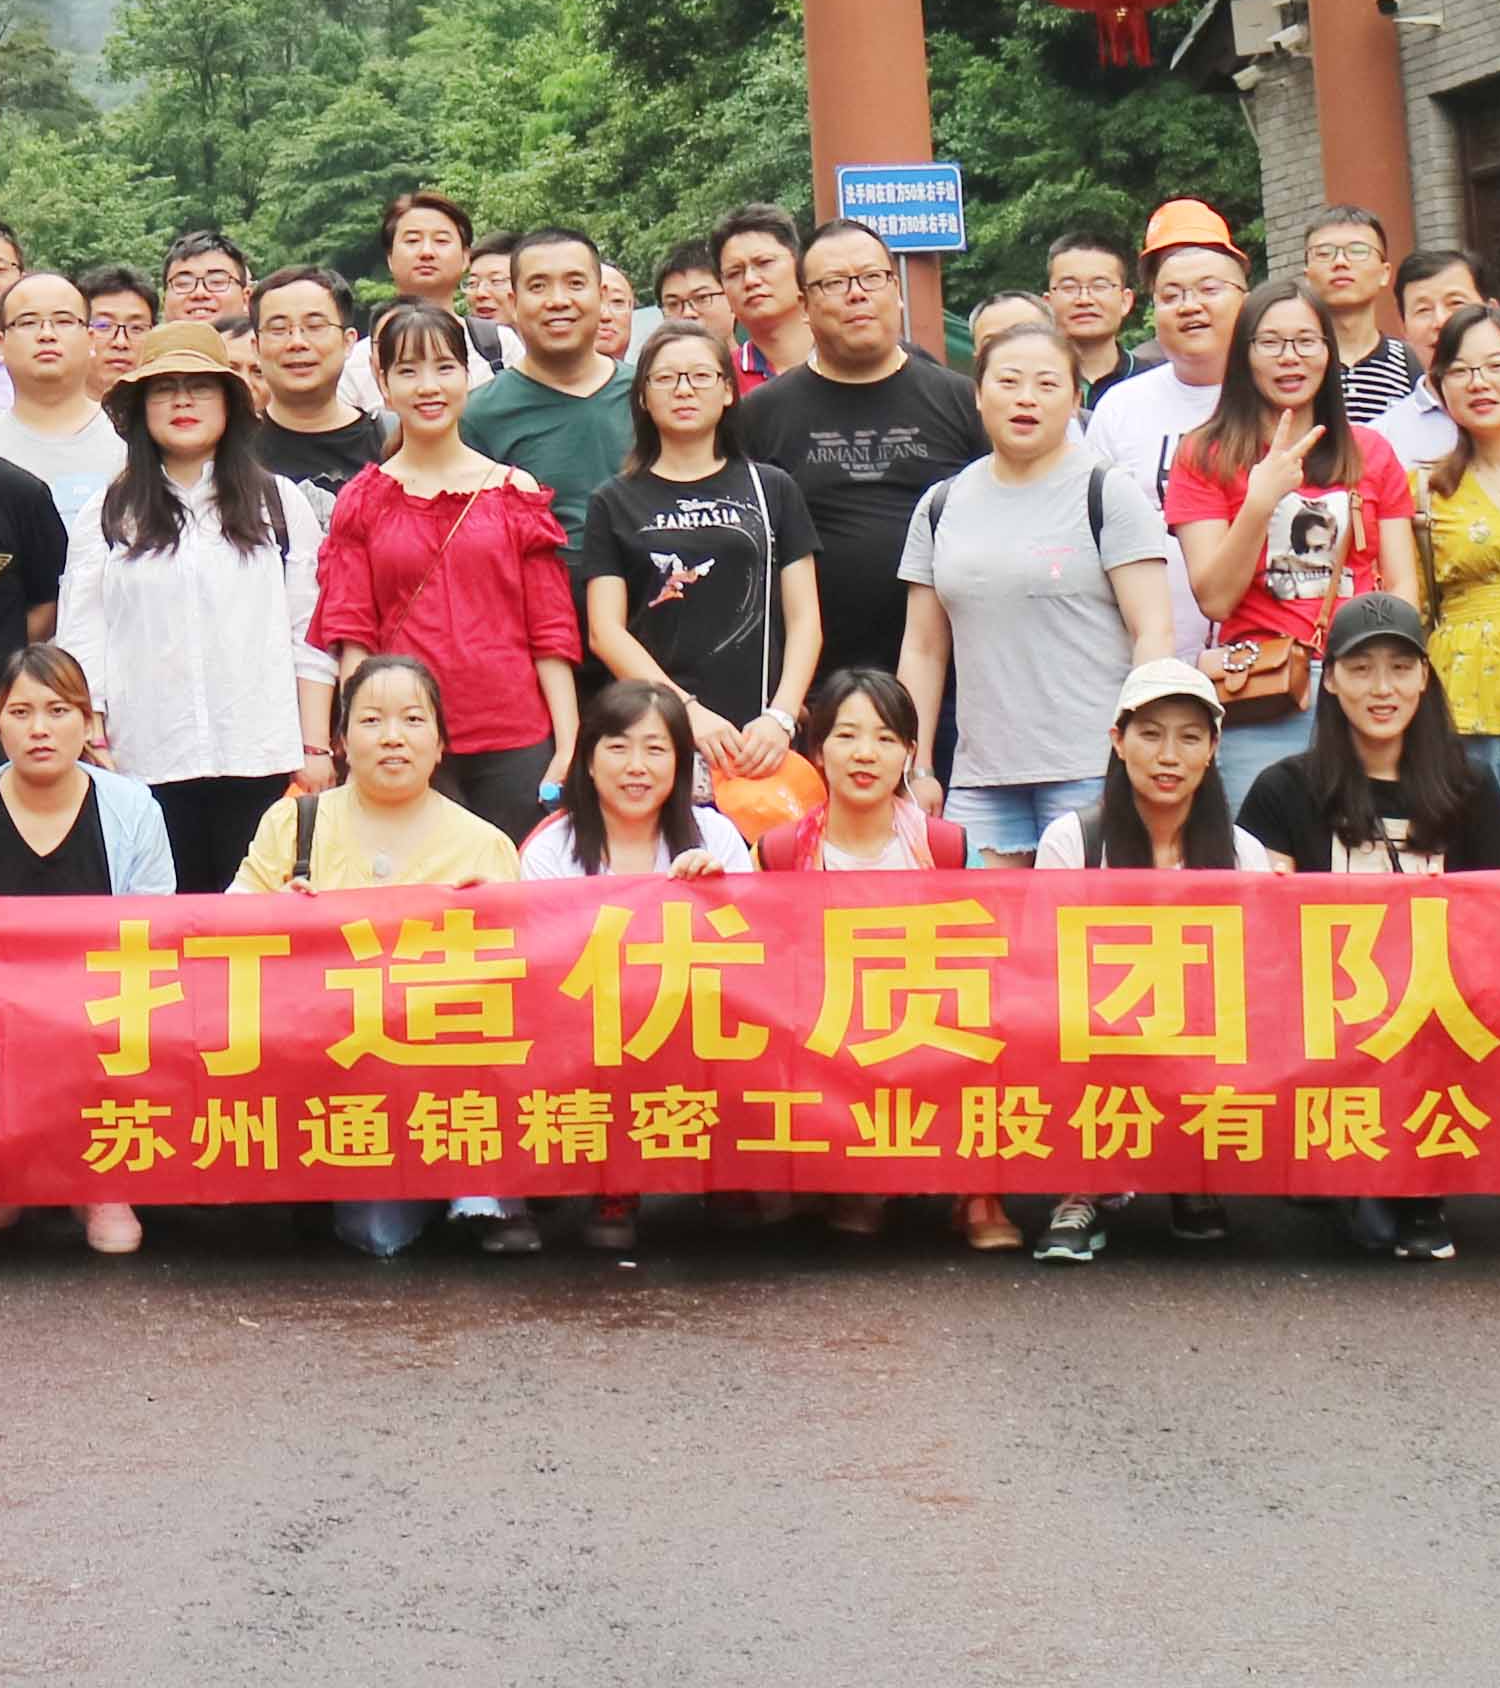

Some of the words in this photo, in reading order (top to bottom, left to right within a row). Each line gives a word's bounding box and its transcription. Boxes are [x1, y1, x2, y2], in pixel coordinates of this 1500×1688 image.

[806, 446, 870, 464] ARMANI
[876, 443, 929, 461] JEANS
[656, 508, 742, 529] FANTASIA
